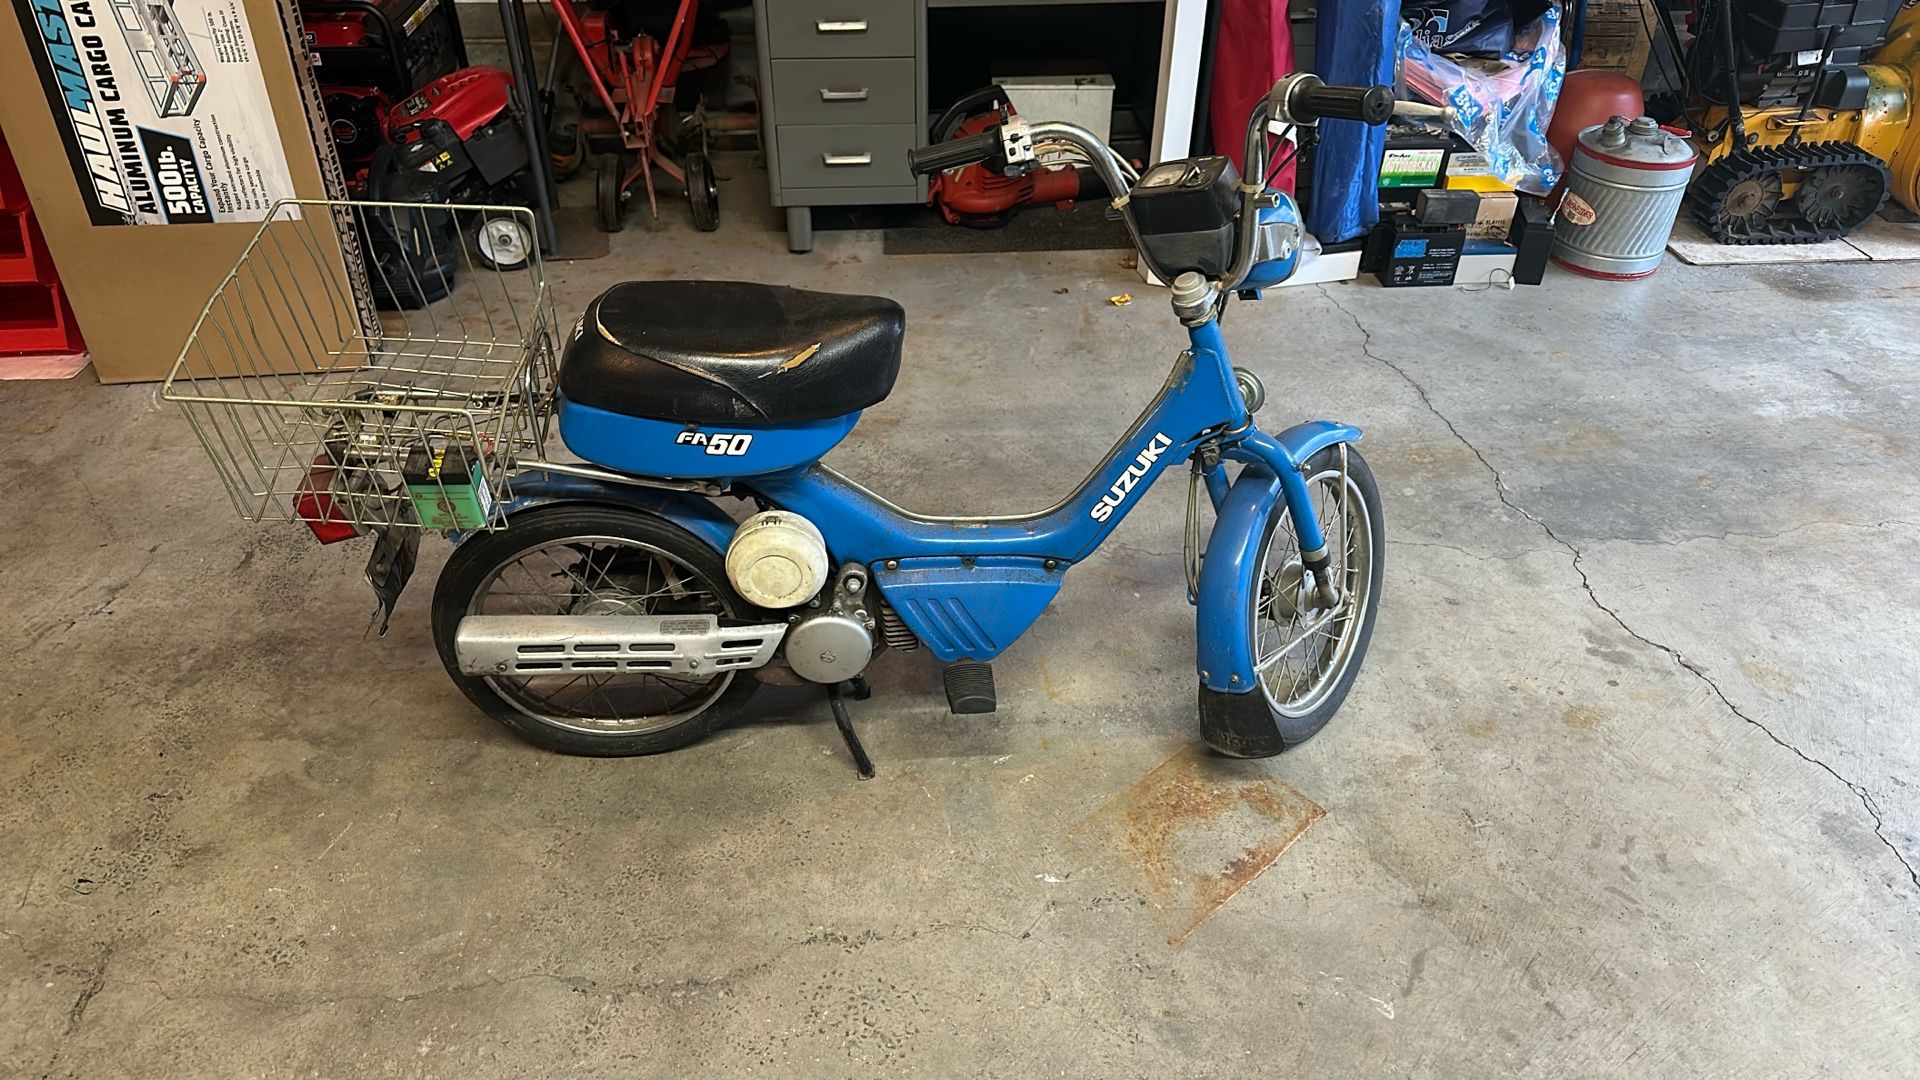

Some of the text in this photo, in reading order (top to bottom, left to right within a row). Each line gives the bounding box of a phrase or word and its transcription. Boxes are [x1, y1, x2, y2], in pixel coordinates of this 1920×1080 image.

[82, 36, 120, 101] CARGO
[306, 66, 325, 122] CARGO
[106, 108, 158, 214] ALUMINUM
[194, 118, 226, 213] Expand Your Cargo Capacity
[211, 114, 242, 210] Rugged extruded aluminum construction
[226, 134, 235, 154] visibility
[242, 156, 250, 170] cargo
[323, 125, 350, 217] AUMINUM
[157, 146, 192, 214] 500lb.
[180, 159, 206, 214] CAPACITY
[221, 182, 234, 213] Instantly
[238, 174, 248, 198] reflectors
[246, 172, 254, 188] secure
[256, 170, 266, 192] assemble
[676, 432, 753, 456] FA50
[1090, 432, 1173, 522] SUZUKI
